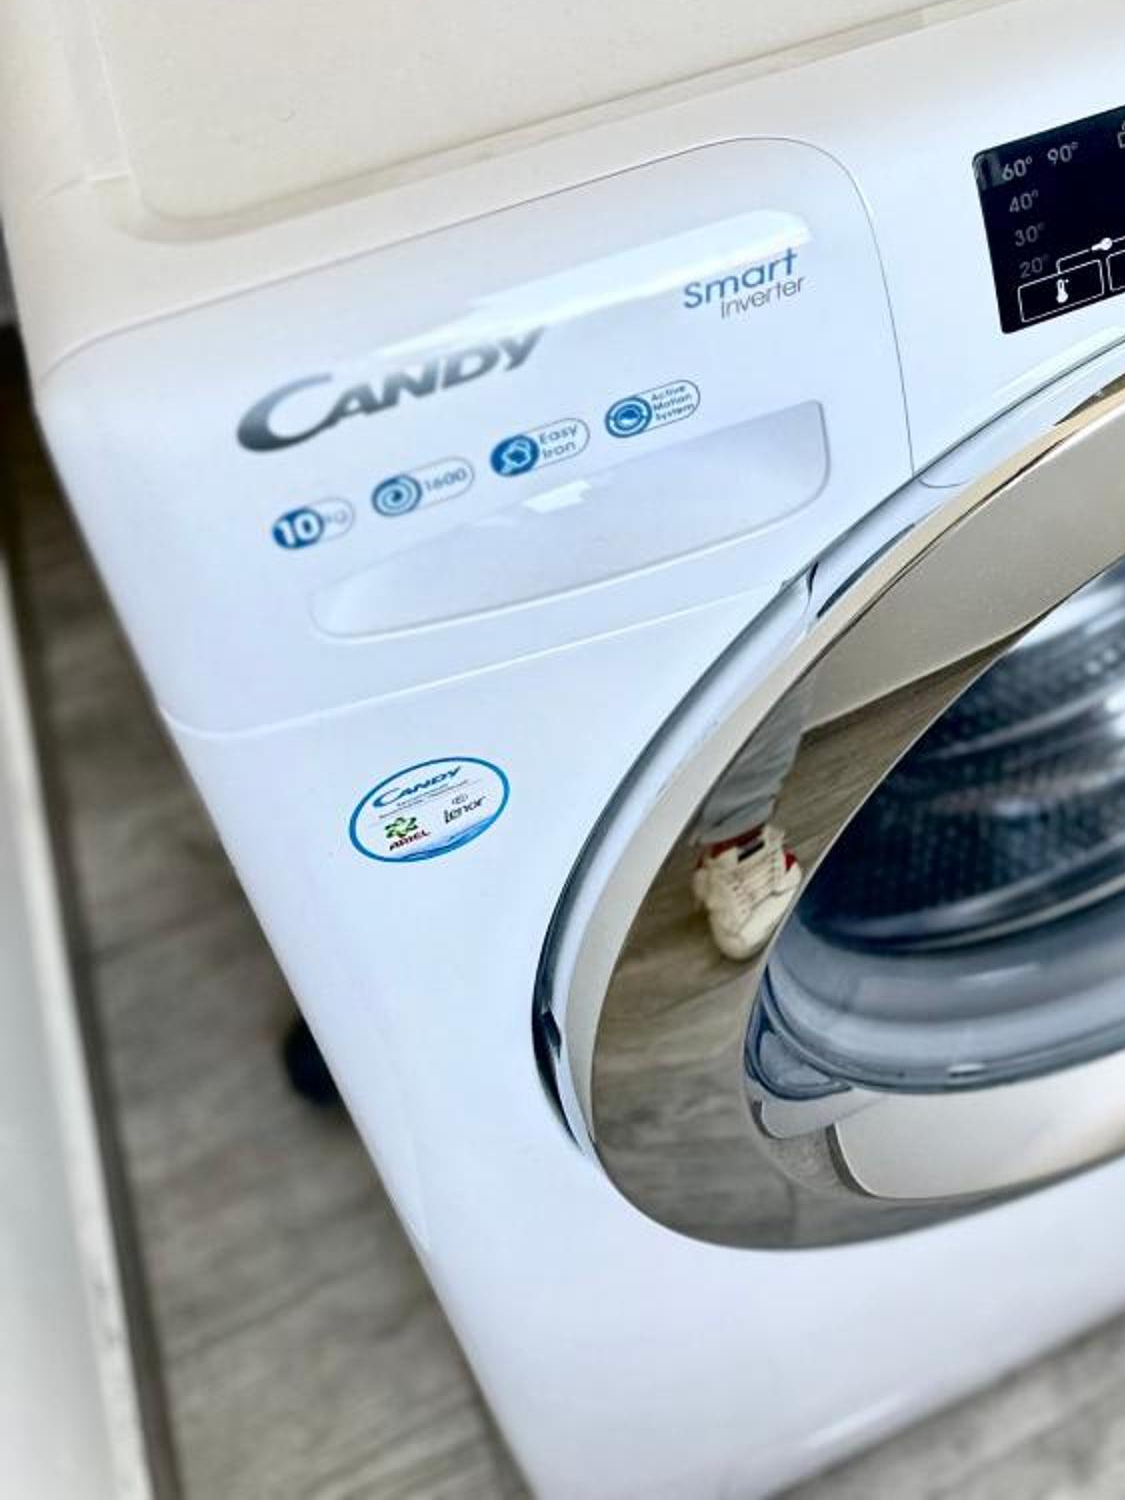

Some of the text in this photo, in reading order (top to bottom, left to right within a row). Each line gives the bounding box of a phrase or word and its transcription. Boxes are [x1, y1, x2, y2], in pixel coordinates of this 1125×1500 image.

[1002, 155, 1033, 181] 60°
[683, 246, 798, 309] Smart
[720, 275, 807, 320] Inverter
[236, 325, 545, 452] CANDY
[651, 384, 687, 402] Active
[652, 392, 693, 412] Motion
[655, 402, 696, 421] System
[538, 423, 579, 446] Easy
[542, 441, 577, 460] Iron
[423, 467, 468, 493] 1600
[279, 513, 321, 548] 10
[372, 765, 462, 809] CANDY
